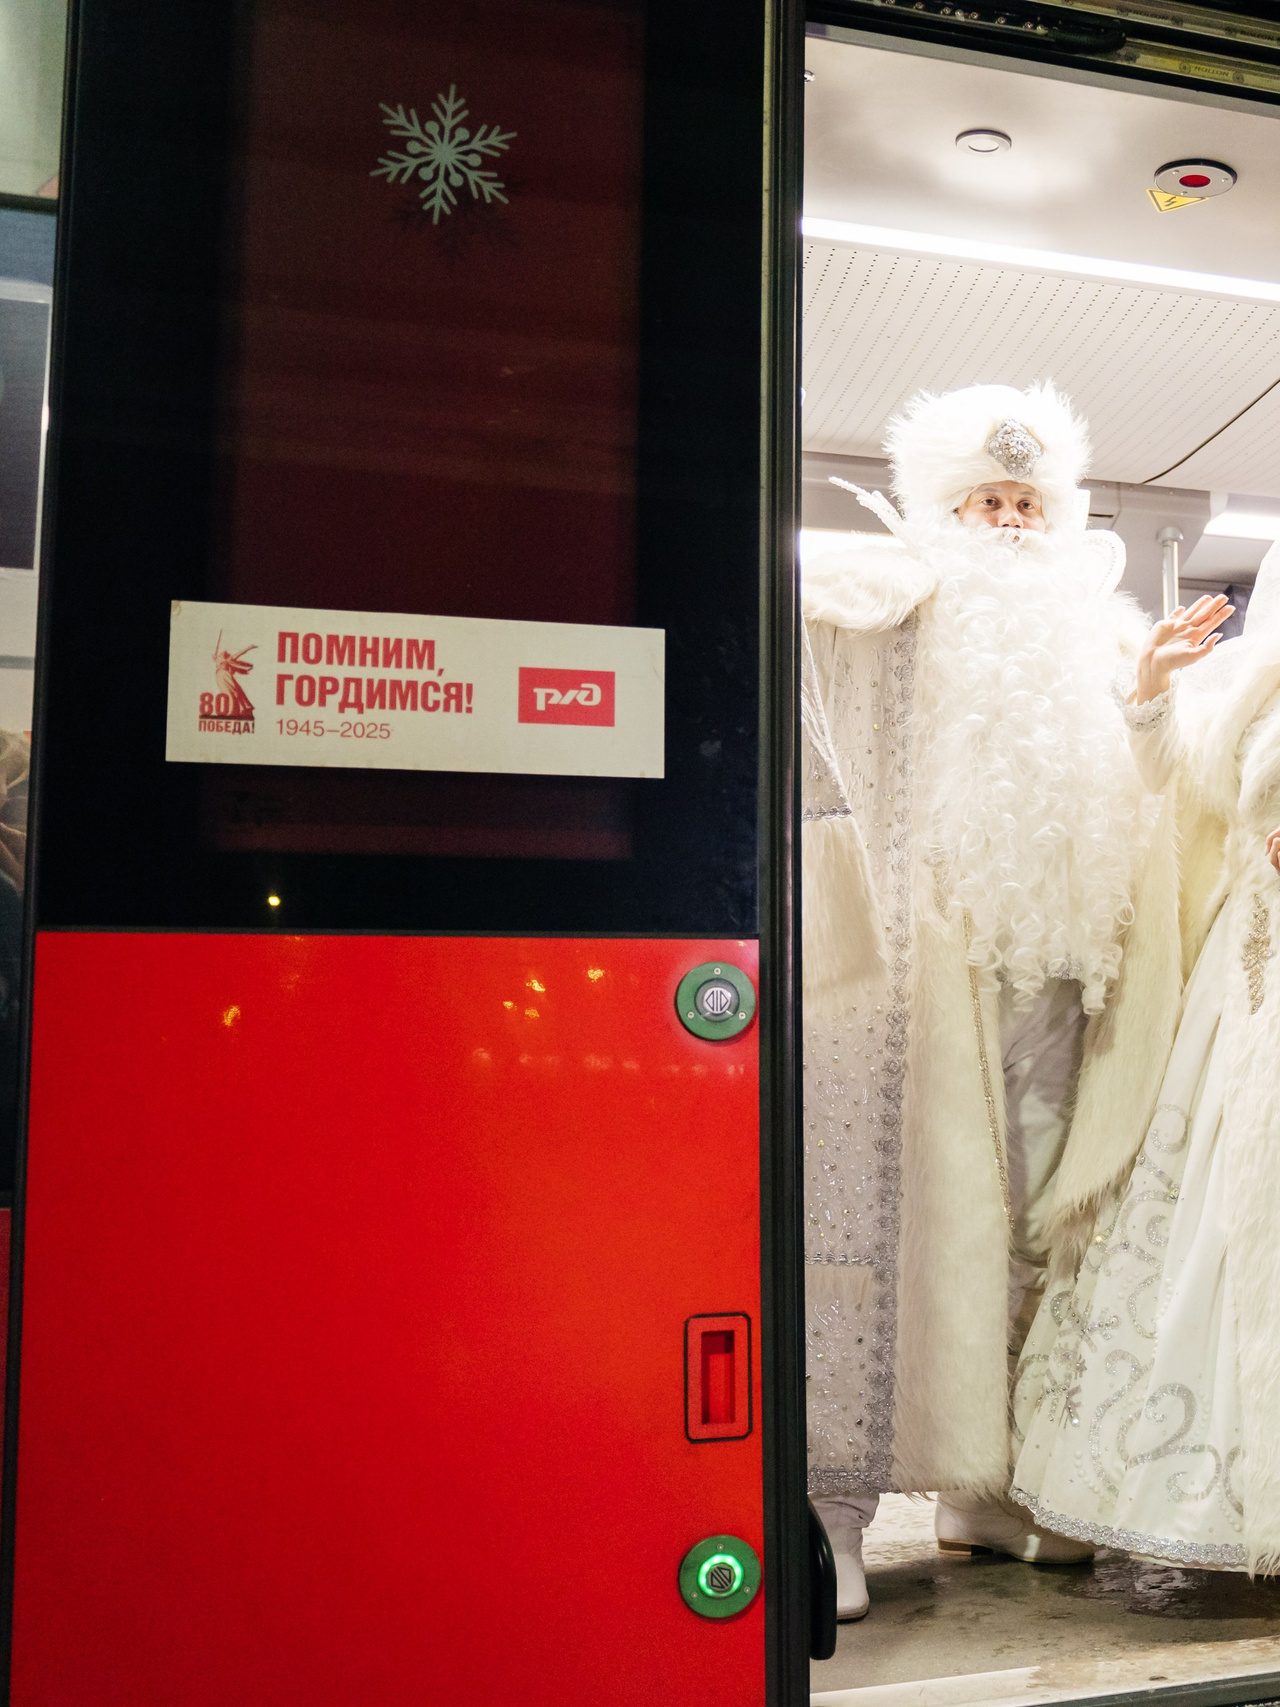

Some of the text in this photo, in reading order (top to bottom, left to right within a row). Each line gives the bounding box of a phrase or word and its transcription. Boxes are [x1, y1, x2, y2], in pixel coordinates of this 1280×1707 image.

[277, 631, 445, 677] ПОМНИМ,
[199, 692, 231, 716] 80
[276, 673, 474, 714] ГОРДИМСЯ!
[198, 720, 255, 735] ПОБЕДА!
